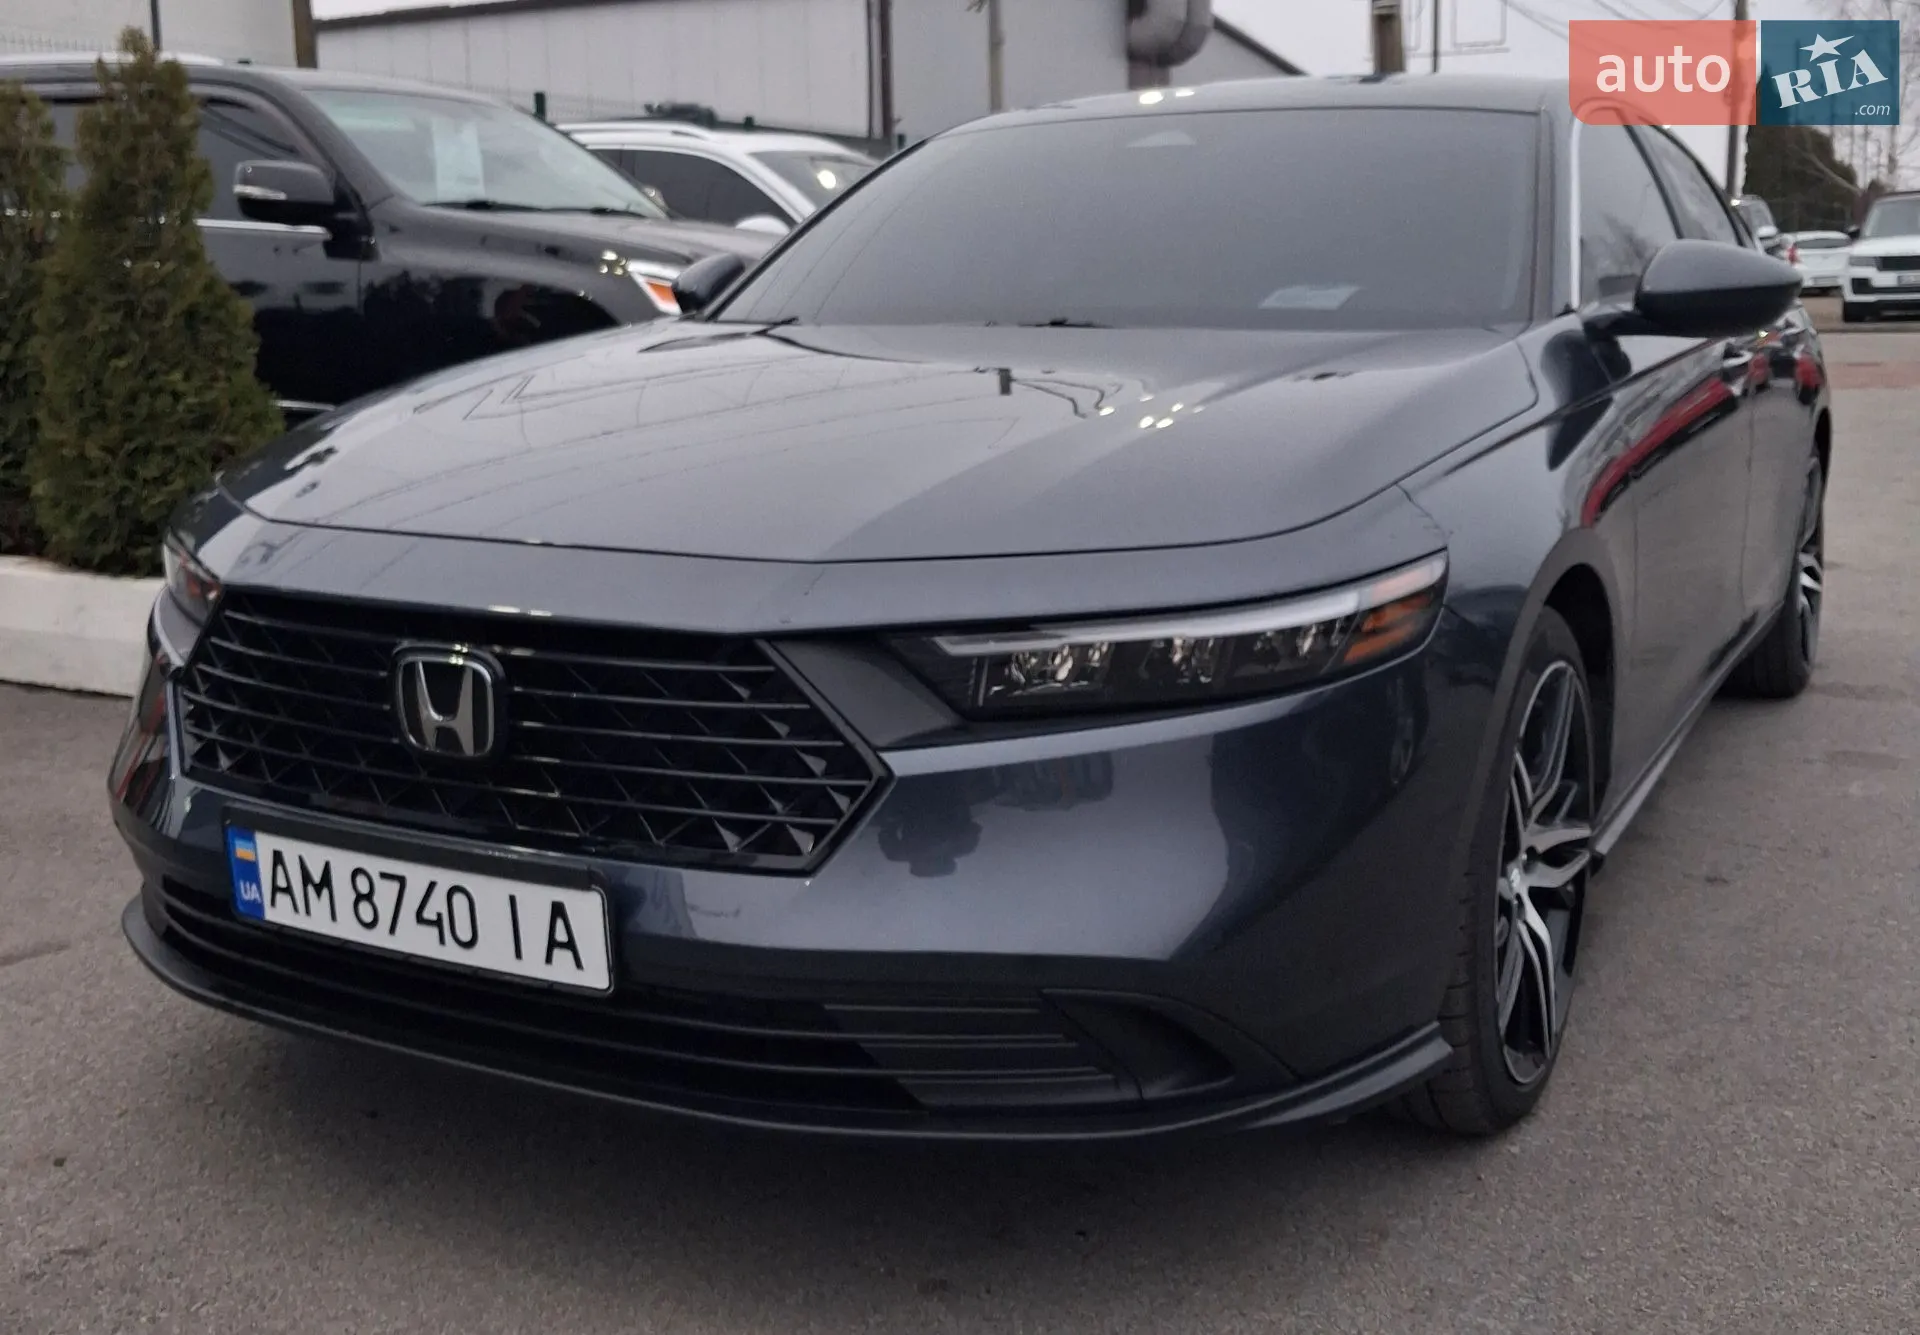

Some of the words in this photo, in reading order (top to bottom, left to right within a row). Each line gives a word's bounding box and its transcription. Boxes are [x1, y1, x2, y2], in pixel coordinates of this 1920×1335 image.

[239, 881, 262, 903] UA
[270, 848, 337, 923] AM
[350, 867, 479, 950] 8740
